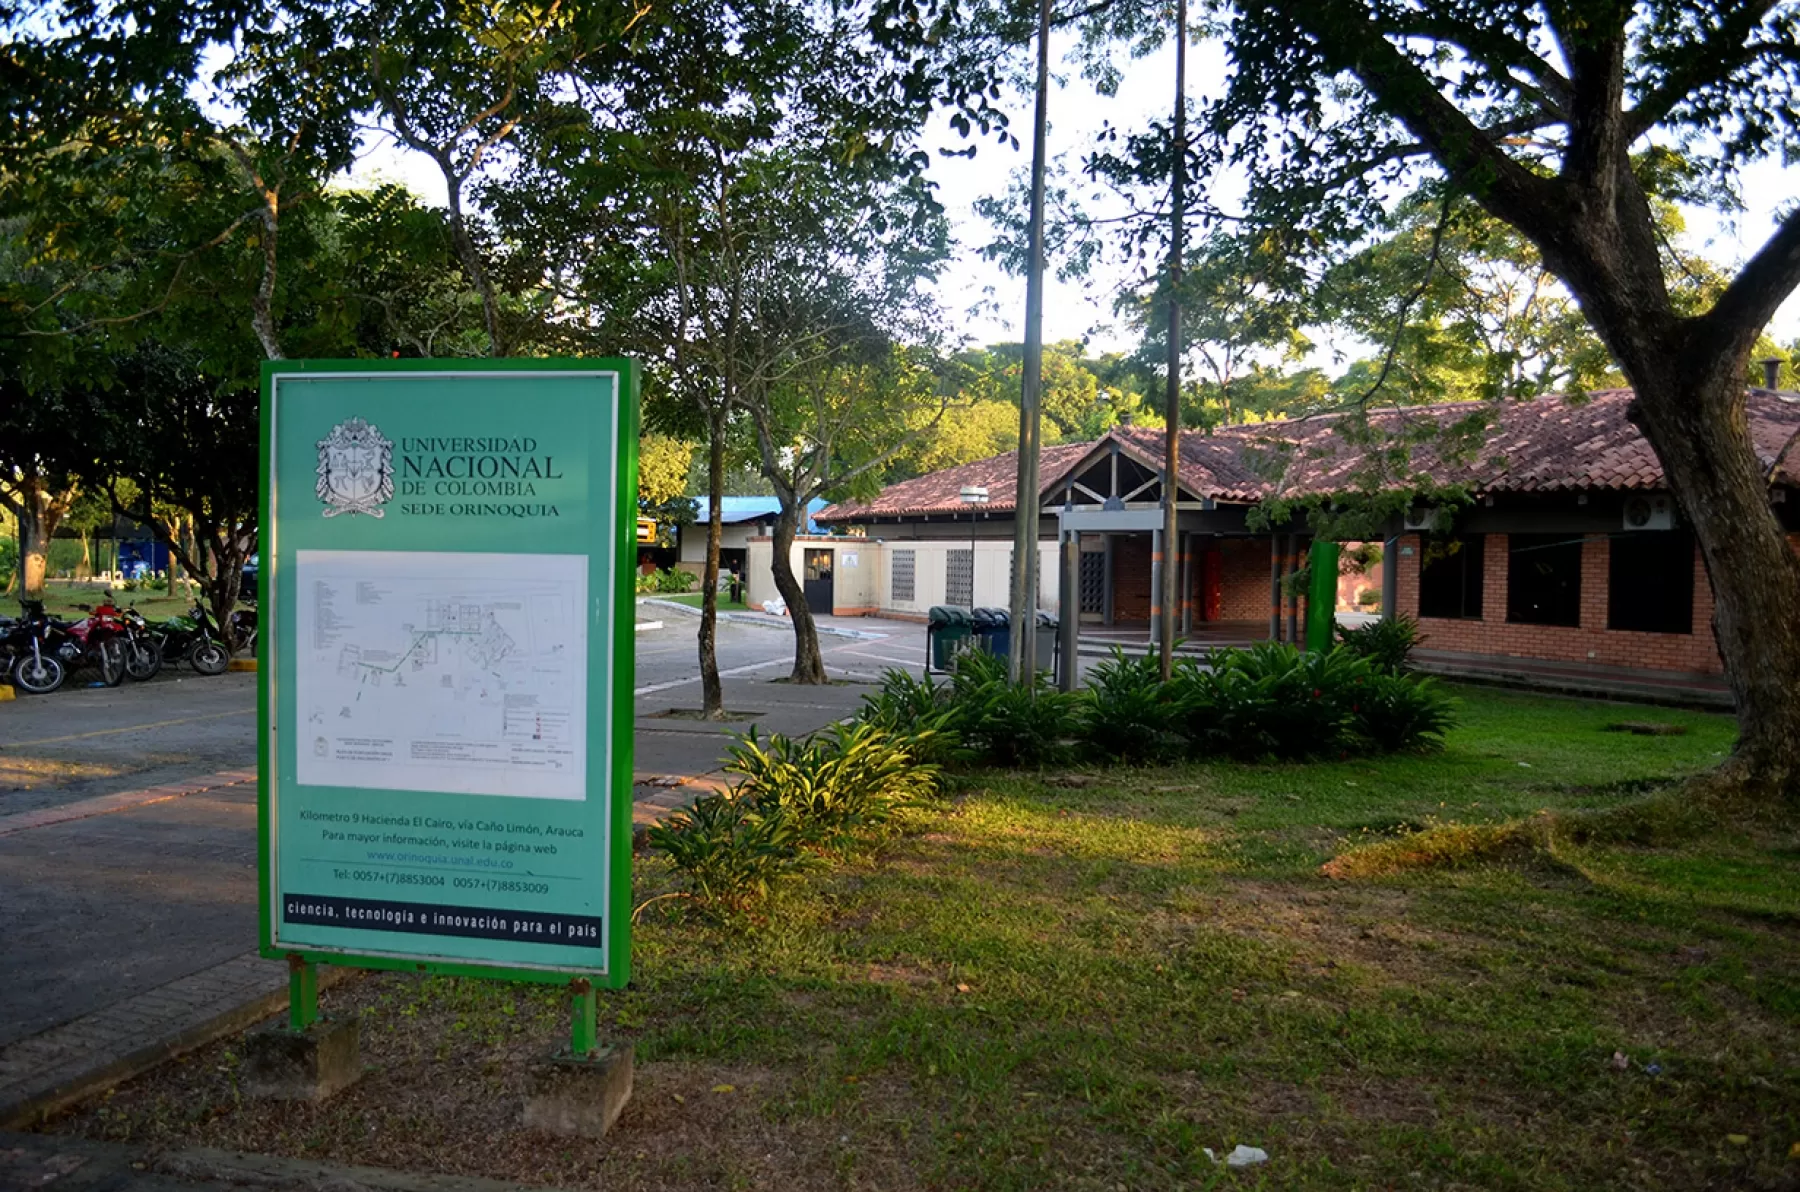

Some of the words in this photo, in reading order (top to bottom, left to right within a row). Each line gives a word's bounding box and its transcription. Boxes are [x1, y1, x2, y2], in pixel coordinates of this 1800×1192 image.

[401, 437, 537, 453] UNIVERSIDAD
[402, 455, 563, 479] NACIONAL
[402, 481, 425, 496] DE
[434, 481, 536, 497] COLOMBIA
[401, 503, 445, 516] SEDE
[449, 503, 560, 518] ORINOQUIA
[352, 813, 359, 823] 9
[361, 814, 410, 827] Hacienda
[413, 816, 422, 827] El
[476, 820, 504, 833] Caño
[506, 823, 543, 836] Limón,
[545, 825, 584, 838] Arauca
[322, 829, 345, 841] Para
[347, 832, 380, 844] mayor
[382, 832, 449, 849] información,
[451, 837, 481, 850] visite
[482, 839, 492, 850] la
[495, 841, 531, 854] página
[533, 844, 558, 855] web
[333, 868, 350, 880] Tel:
[287, 901, 339, 919] ciencia,
[420, 913, 427, 924] e
[433, 912, 507, 930] innovación
[513, 919, 543, 933] para
[549, 921, 562, 935] el
